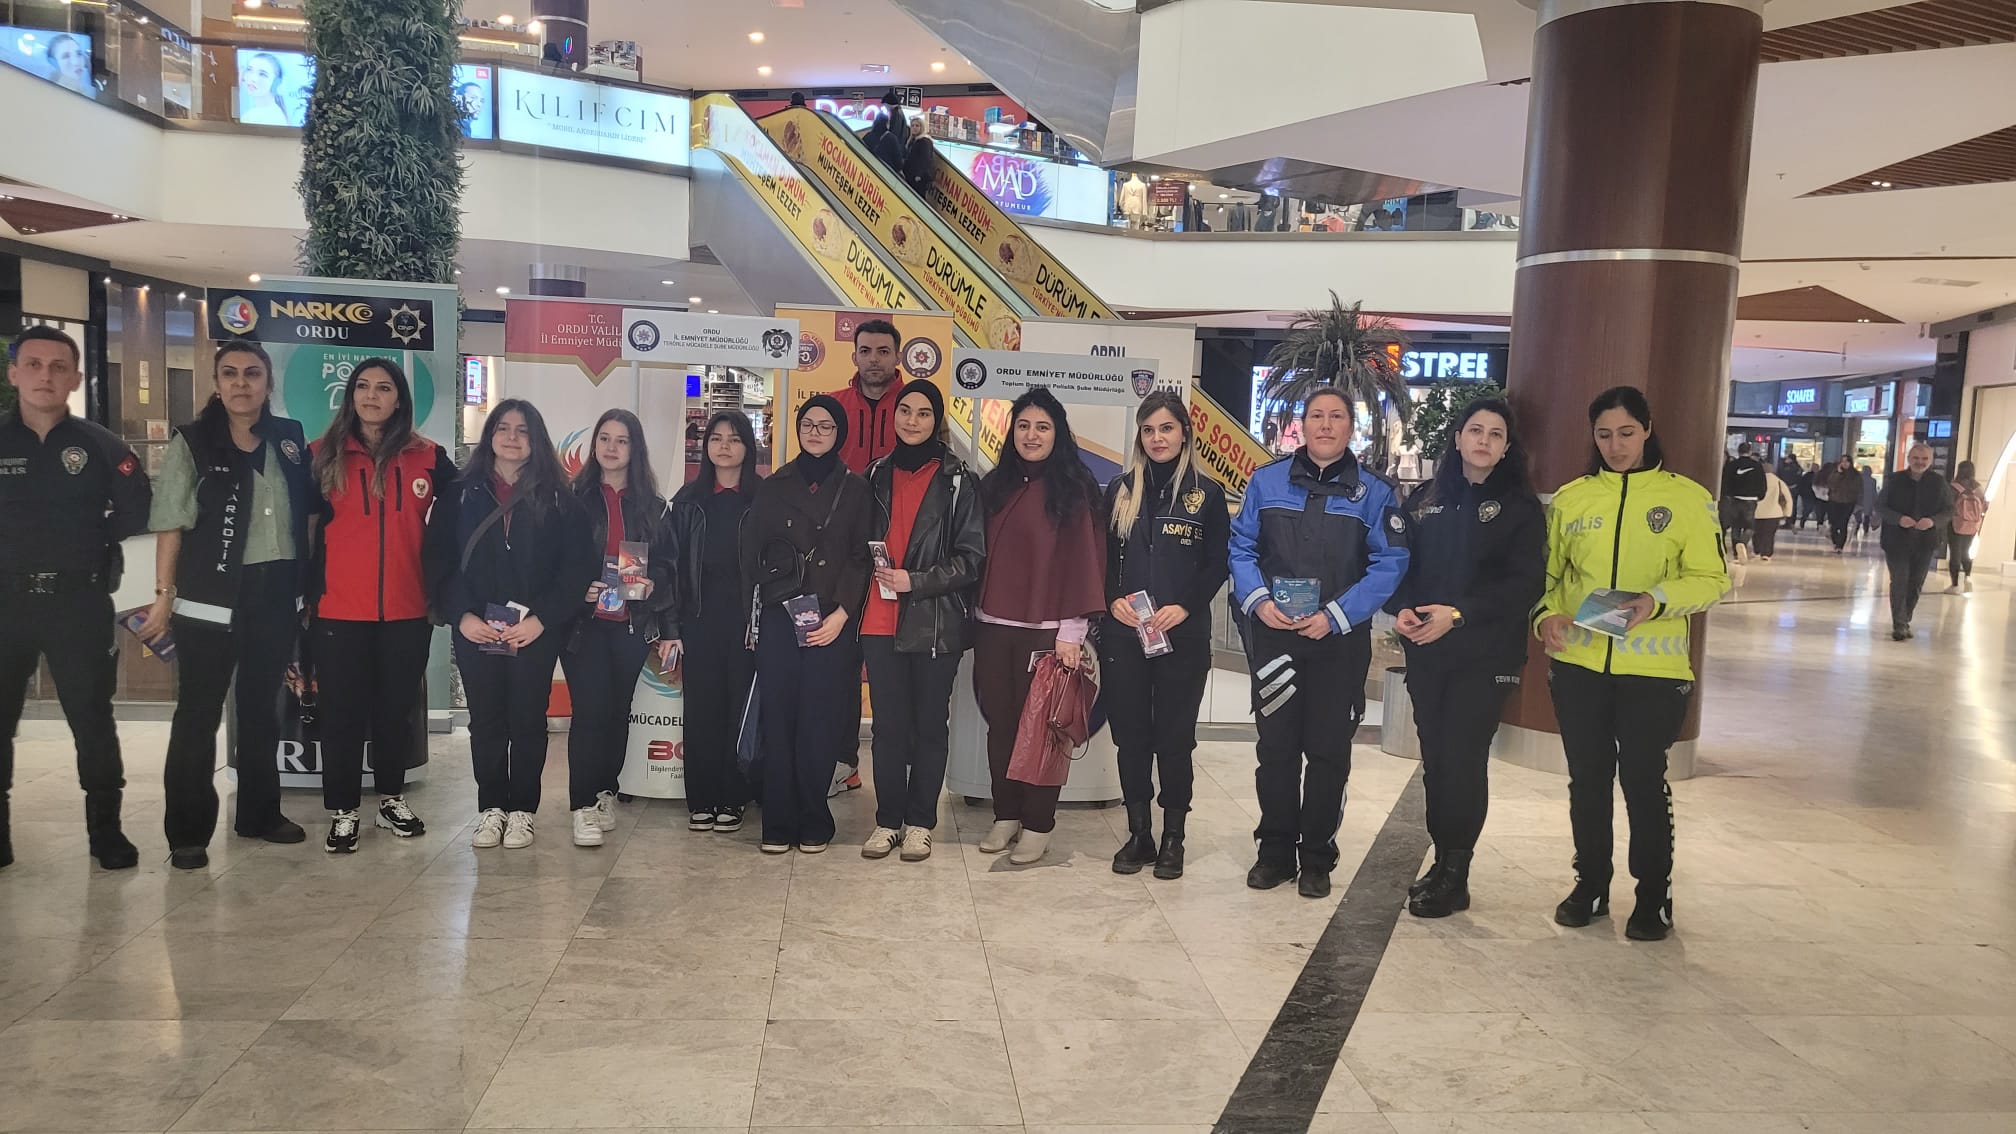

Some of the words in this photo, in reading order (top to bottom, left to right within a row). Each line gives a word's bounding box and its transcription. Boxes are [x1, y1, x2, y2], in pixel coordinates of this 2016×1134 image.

[817, 152, 854, 199] MUHTEŞEM
[854, 190, 881, 227] LEZZET
[821, 136, 858, 183] KOCAMAN
[857, 169, 885, 211] DÜRÜM
[981, 163, 1037, 200] MAD
[777, 186, 801, 221] LEZZET
[961, 191, 991, 232] DÜRÜM
[958, 211, 987, 244] LEZZET
[846, 240, 906, 309] DÜRÜMLE
[926, 246, 987, 319] DÜRÜMLE
[296, 324, 350, 340] ORDU
[557, 324, 588, 335] ORDU
[590, 325, 622, 336] VALİL
[588, 314, 606, 325] T.C.
[323, 353, 334, 361] EN
[551, 334, 594, 348] Emniyet
[709, 336, 749, 345] MÜDÜRLÜĞÜ
[996, 367, 1022, 376] ORDU
[1026, 369, 1066, 379] EMNİYET
[1068, 371, 1124, 382] MÜDÜRLÜĞÜ
[1195, 436, 1248, 494] DÜRÜMLE
[1209, 424, 1258, 477] SOSLU
[628, 713, 684, 727] MÜCADEL
